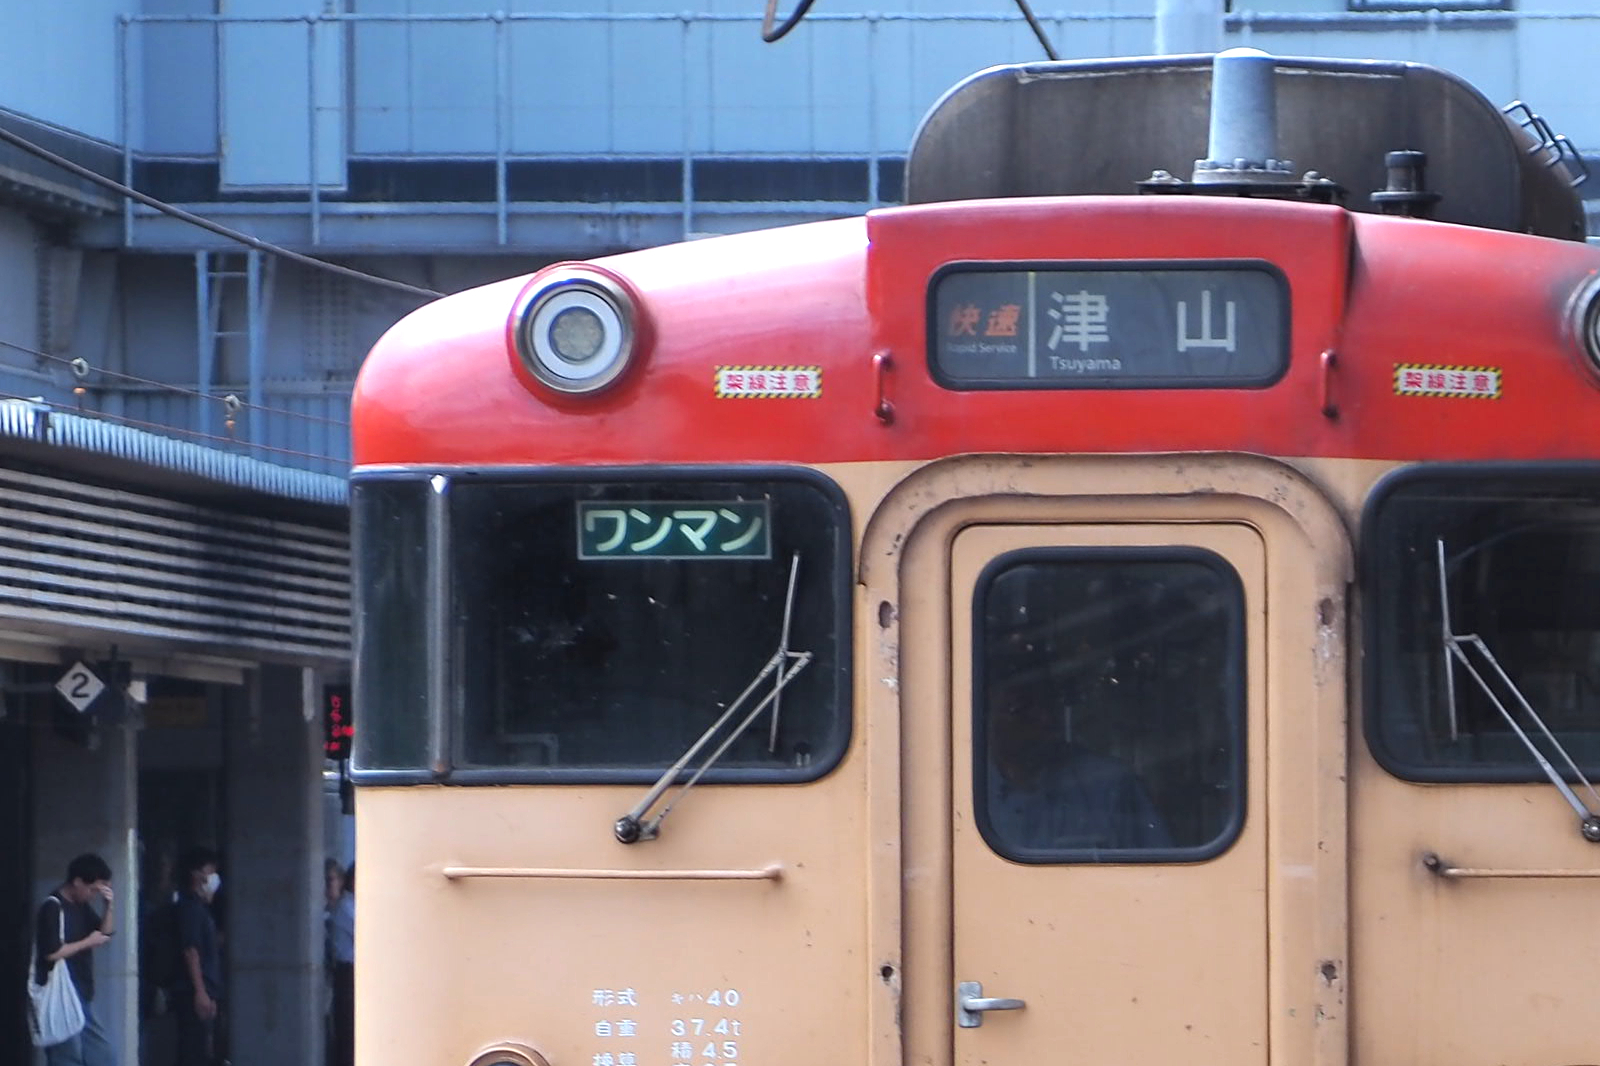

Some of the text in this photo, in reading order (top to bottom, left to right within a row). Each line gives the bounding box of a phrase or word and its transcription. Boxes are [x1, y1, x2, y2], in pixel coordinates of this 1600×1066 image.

[948, 303, 1021, 337] 快速
[1047, 290, 1237, 353] 津山
[1049, 356, 1121, 372] Tsuyama
[726, 374, 810, 391] 架線注意
[1404, 372, 1490, 391] 架線注意
[585, 508, 762, 551] ワンマン
[70, 672, 91, 699] 2
[592, 988, 638, 1007] 形式
[595, 1019, 637, 1037] 自重
